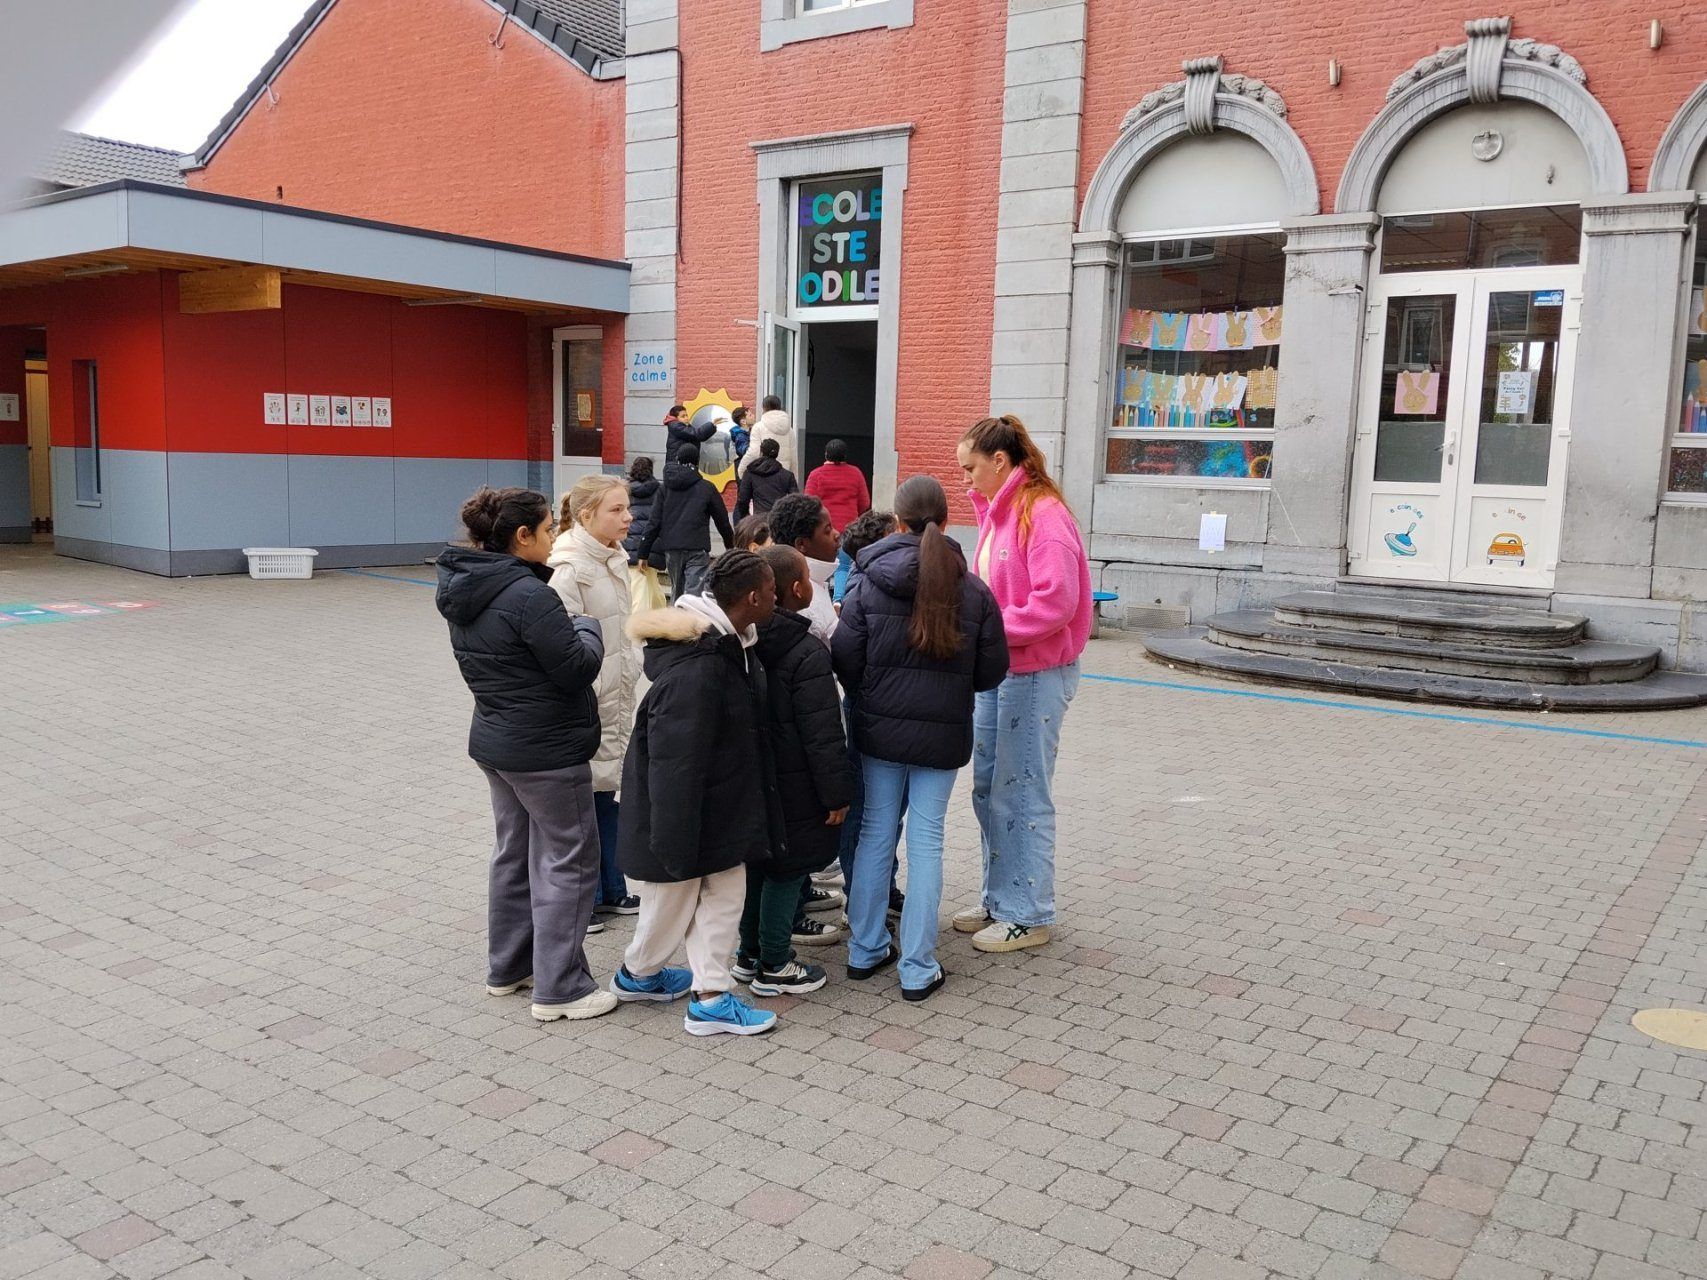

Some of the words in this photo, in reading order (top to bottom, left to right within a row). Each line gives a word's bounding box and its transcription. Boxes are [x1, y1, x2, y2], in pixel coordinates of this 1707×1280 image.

[799, 188, 882, 227] ECOLE
[812, 229, 867, 264] STE
[799, 269, 879, 303] ODILE
[631, 370, 667, 382] calme
[634, 353, 664, 366] Zone
